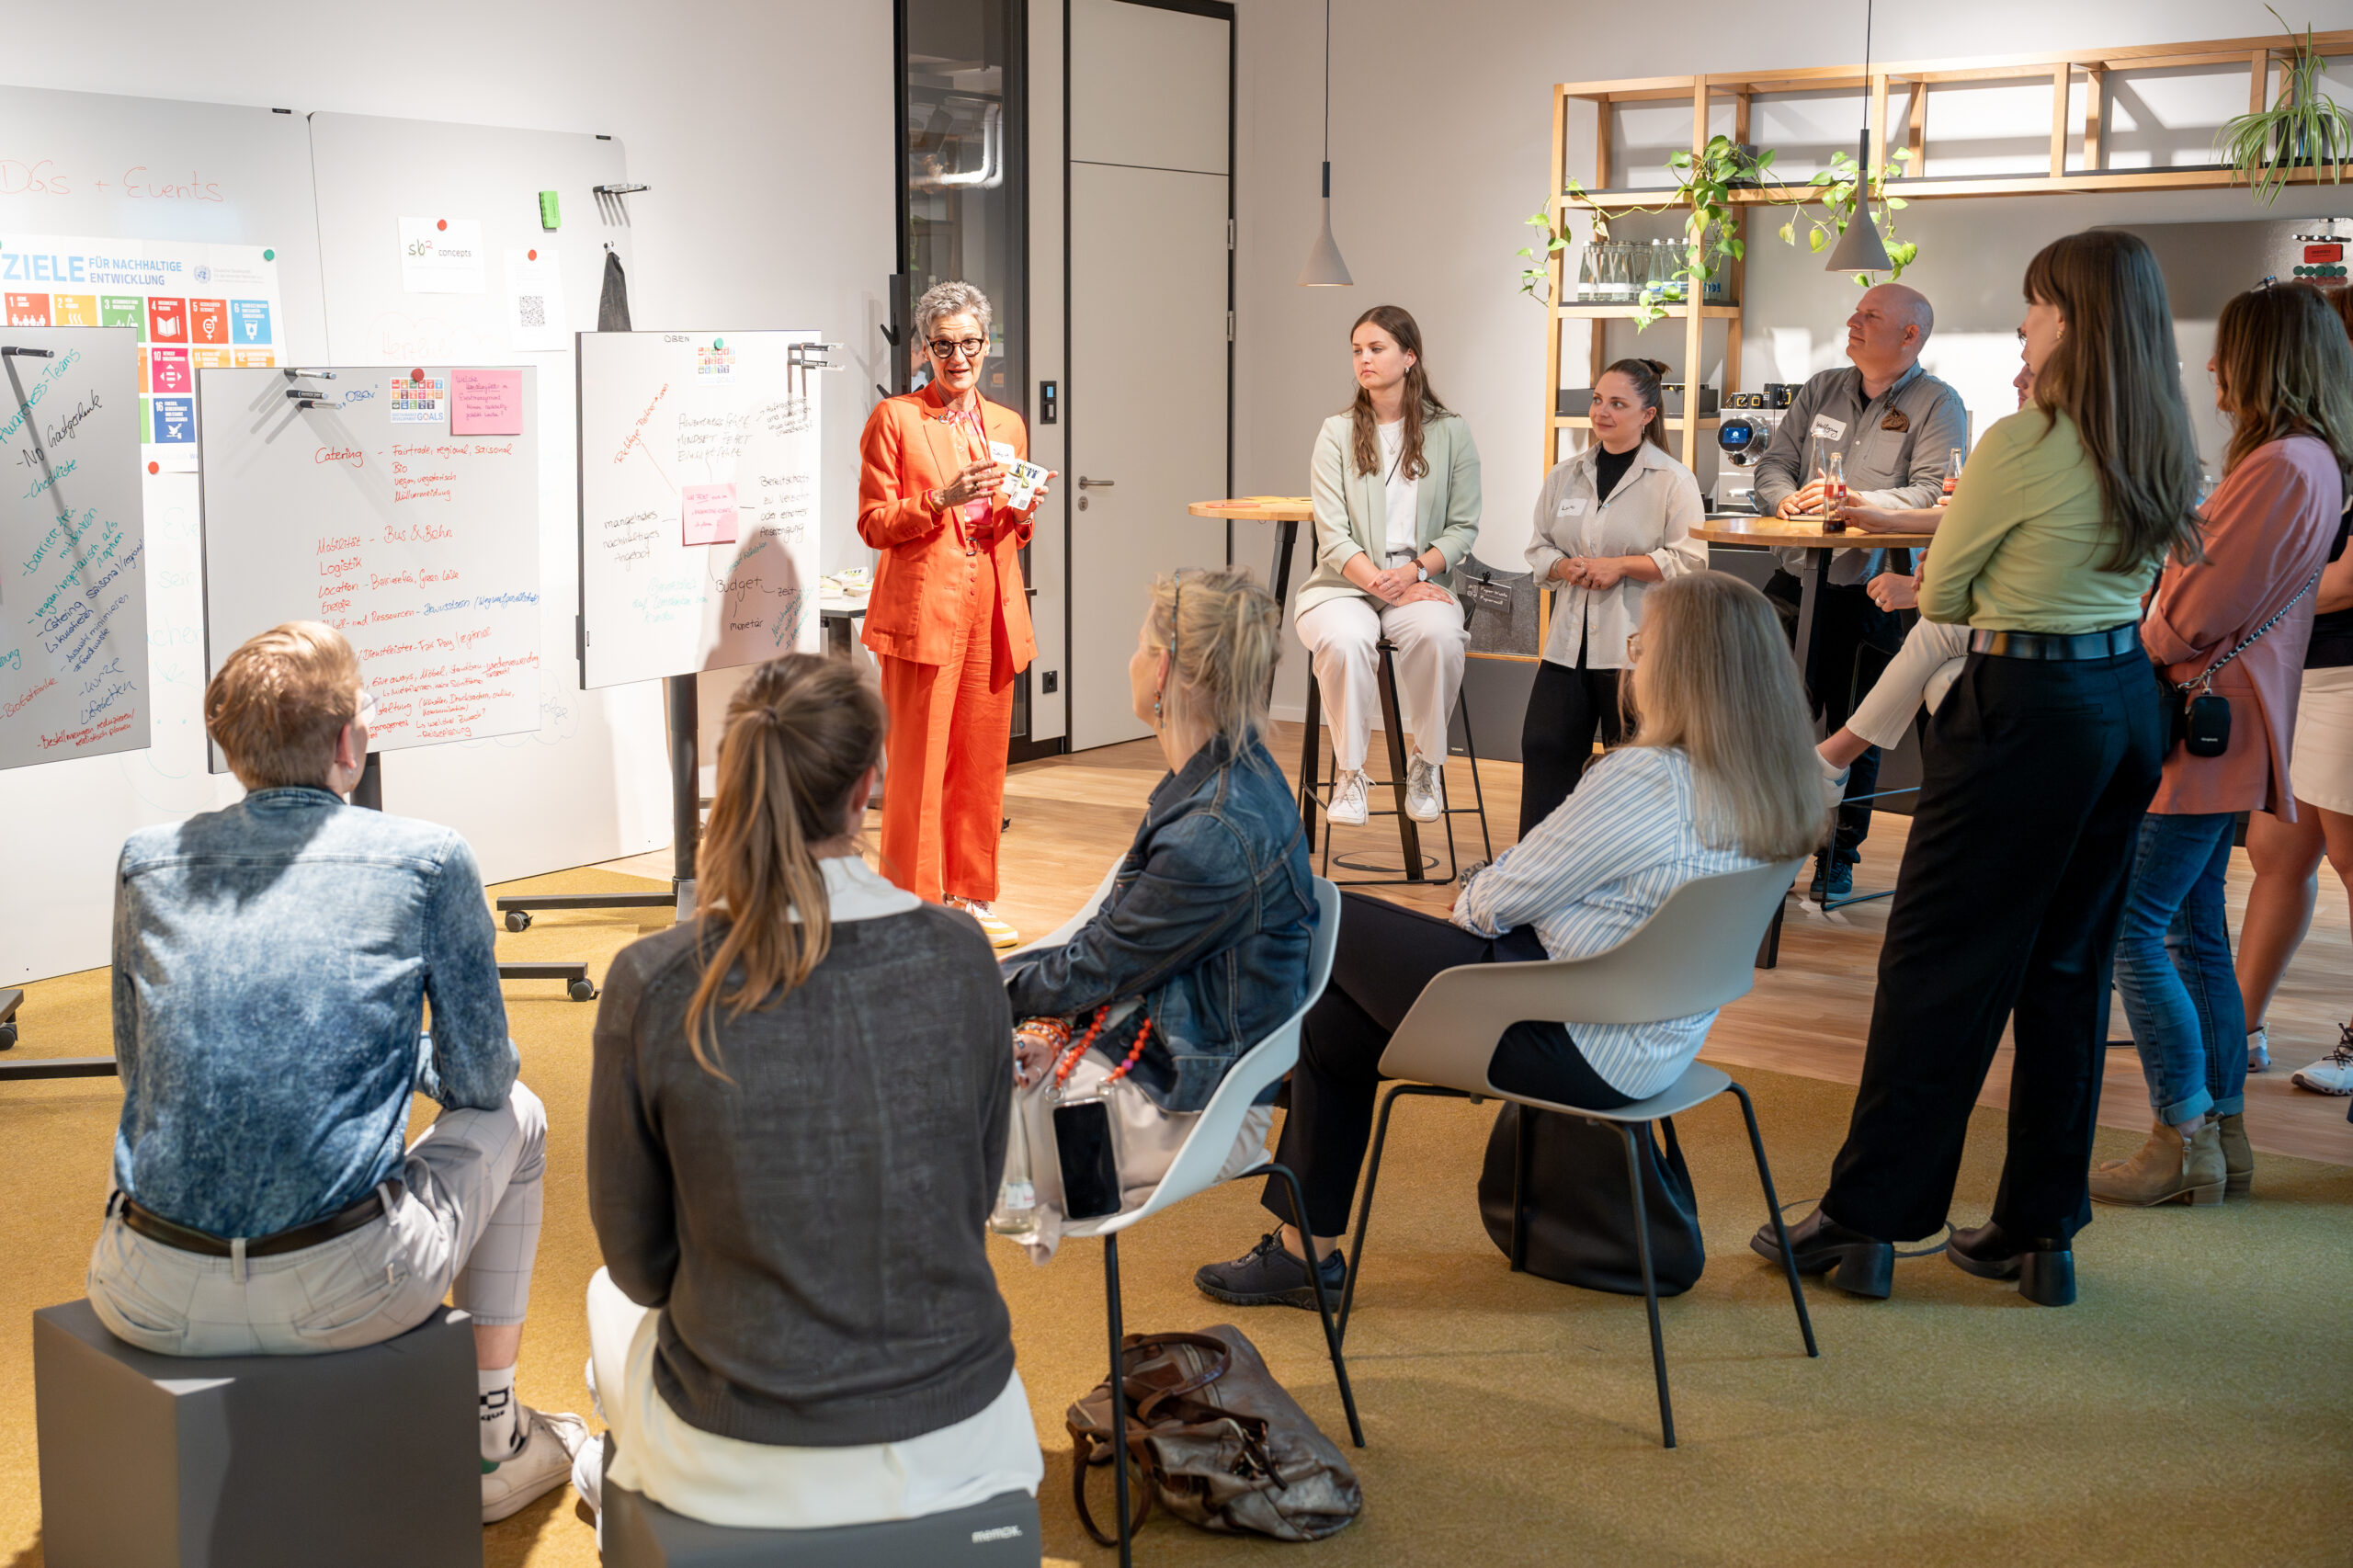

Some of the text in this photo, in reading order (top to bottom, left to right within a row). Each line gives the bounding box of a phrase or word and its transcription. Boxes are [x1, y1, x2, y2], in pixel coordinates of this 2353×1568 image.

[123, 166, 223, 202] Events
[438, 248, 472, 258] concepts
[1, 254, 85, 283] ZIELE
[89, 256, 183, 272] FÜR NACHHALTIGE
[90, 273, 165, 286] ENTWICKLUNG
[664, 335, 690, 343] OBEN
[417, 413, 445, 422] GOALS
[314, 445, 365, 469] Catering
[392, 461, 409, 474] Bio
[603, 510, 660, 537] mangelndes
[316, 536, 362, 556] Mobilität
[384, 525, 407, 544] Bus
[410, 524, 424, 541] &
[319, 556, 364, 578] Logistik
[317, 582, 360, 599] Location
[714, 575, 764, 603] Budget
[321, 598, 353, 615] Energie
[377, 702, 414, 719] staltung
[369, 720, 410, 734] management
